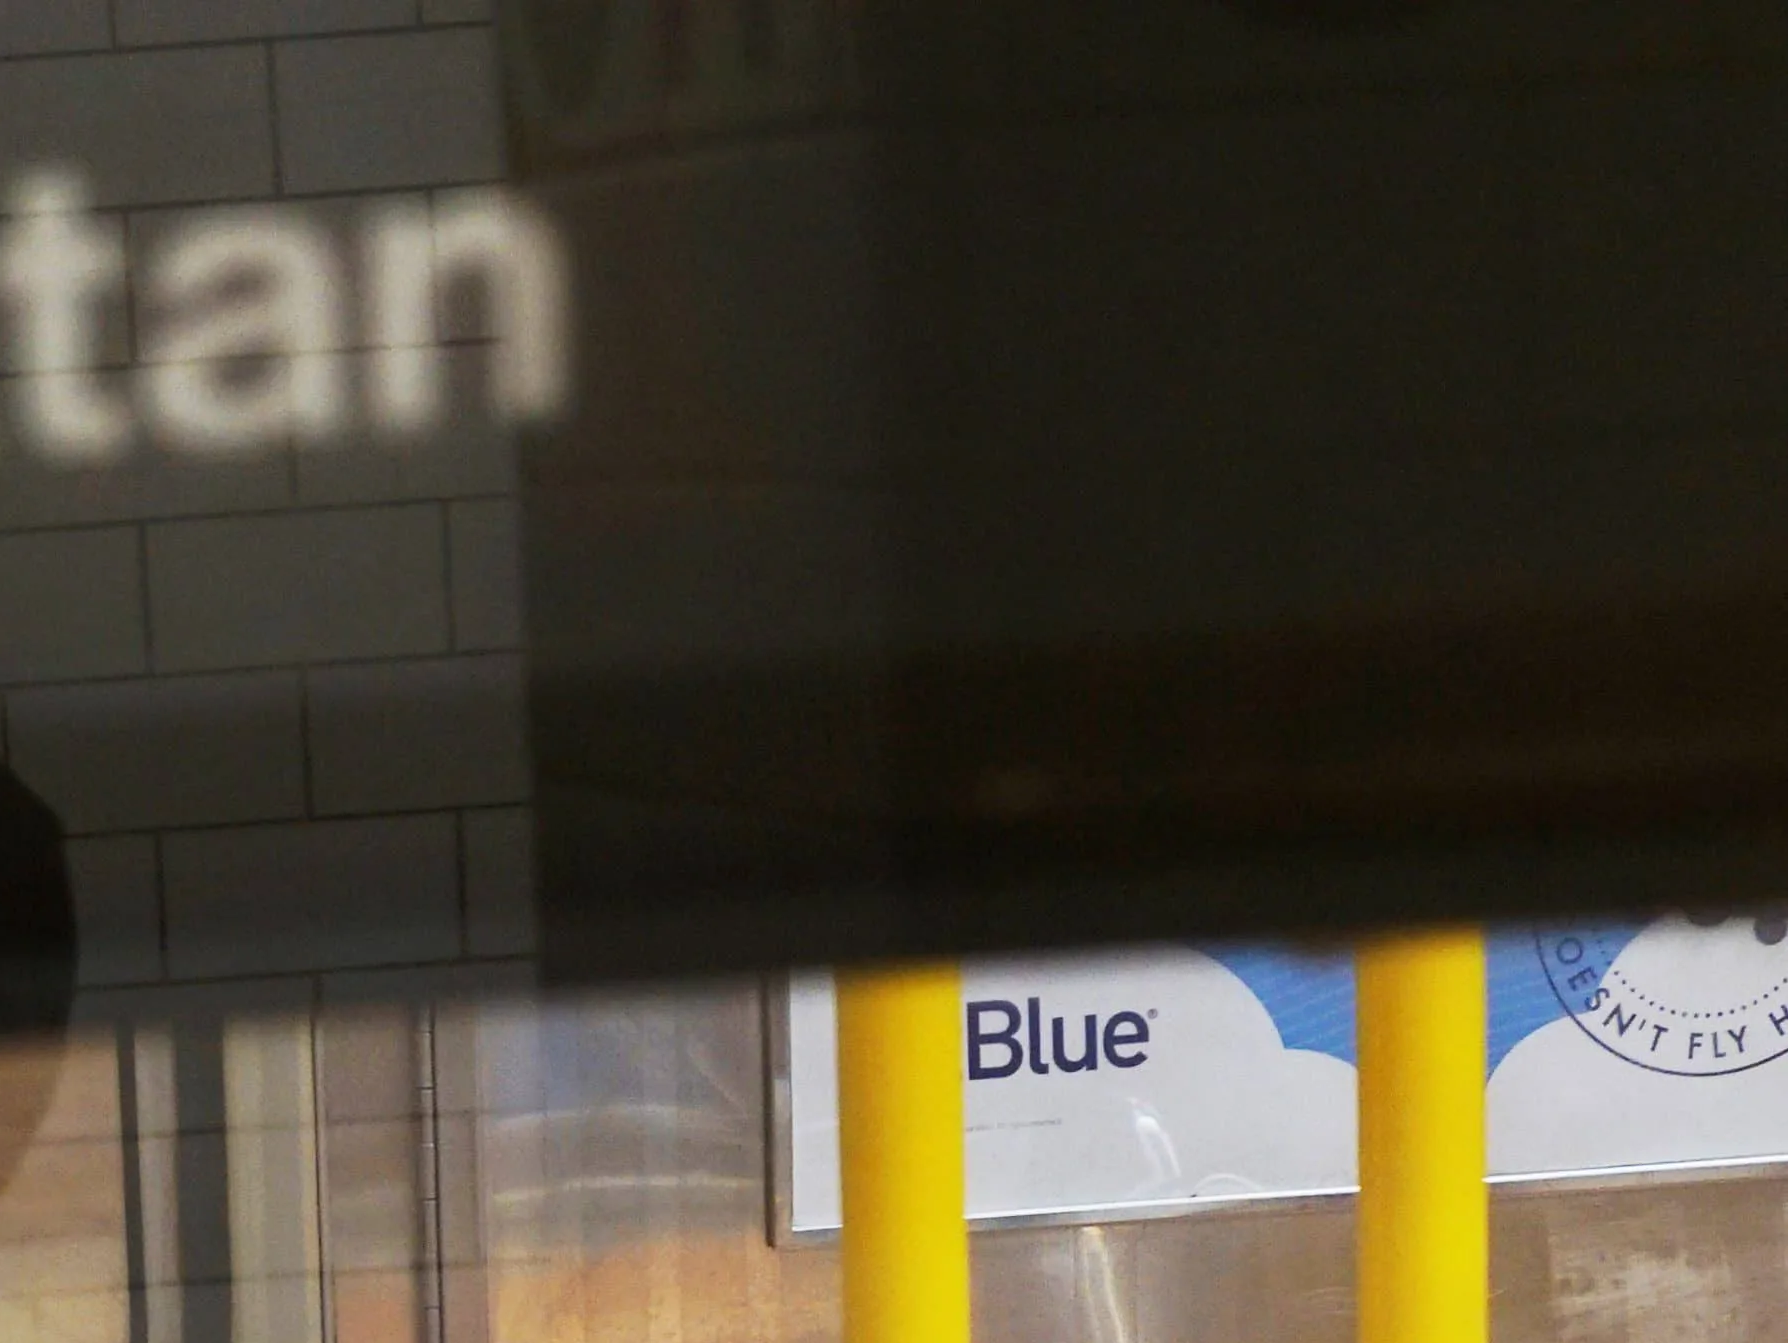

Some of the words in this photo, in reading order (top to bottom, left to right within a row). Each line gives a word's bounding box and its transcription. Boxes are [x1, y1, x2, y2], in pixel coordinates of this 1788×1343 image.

[963, 993, 1149, 1081] Blue
[1555, 936, 1668, 1052] OESN'T
[1687, 1025, 1747, 1060] FLY
